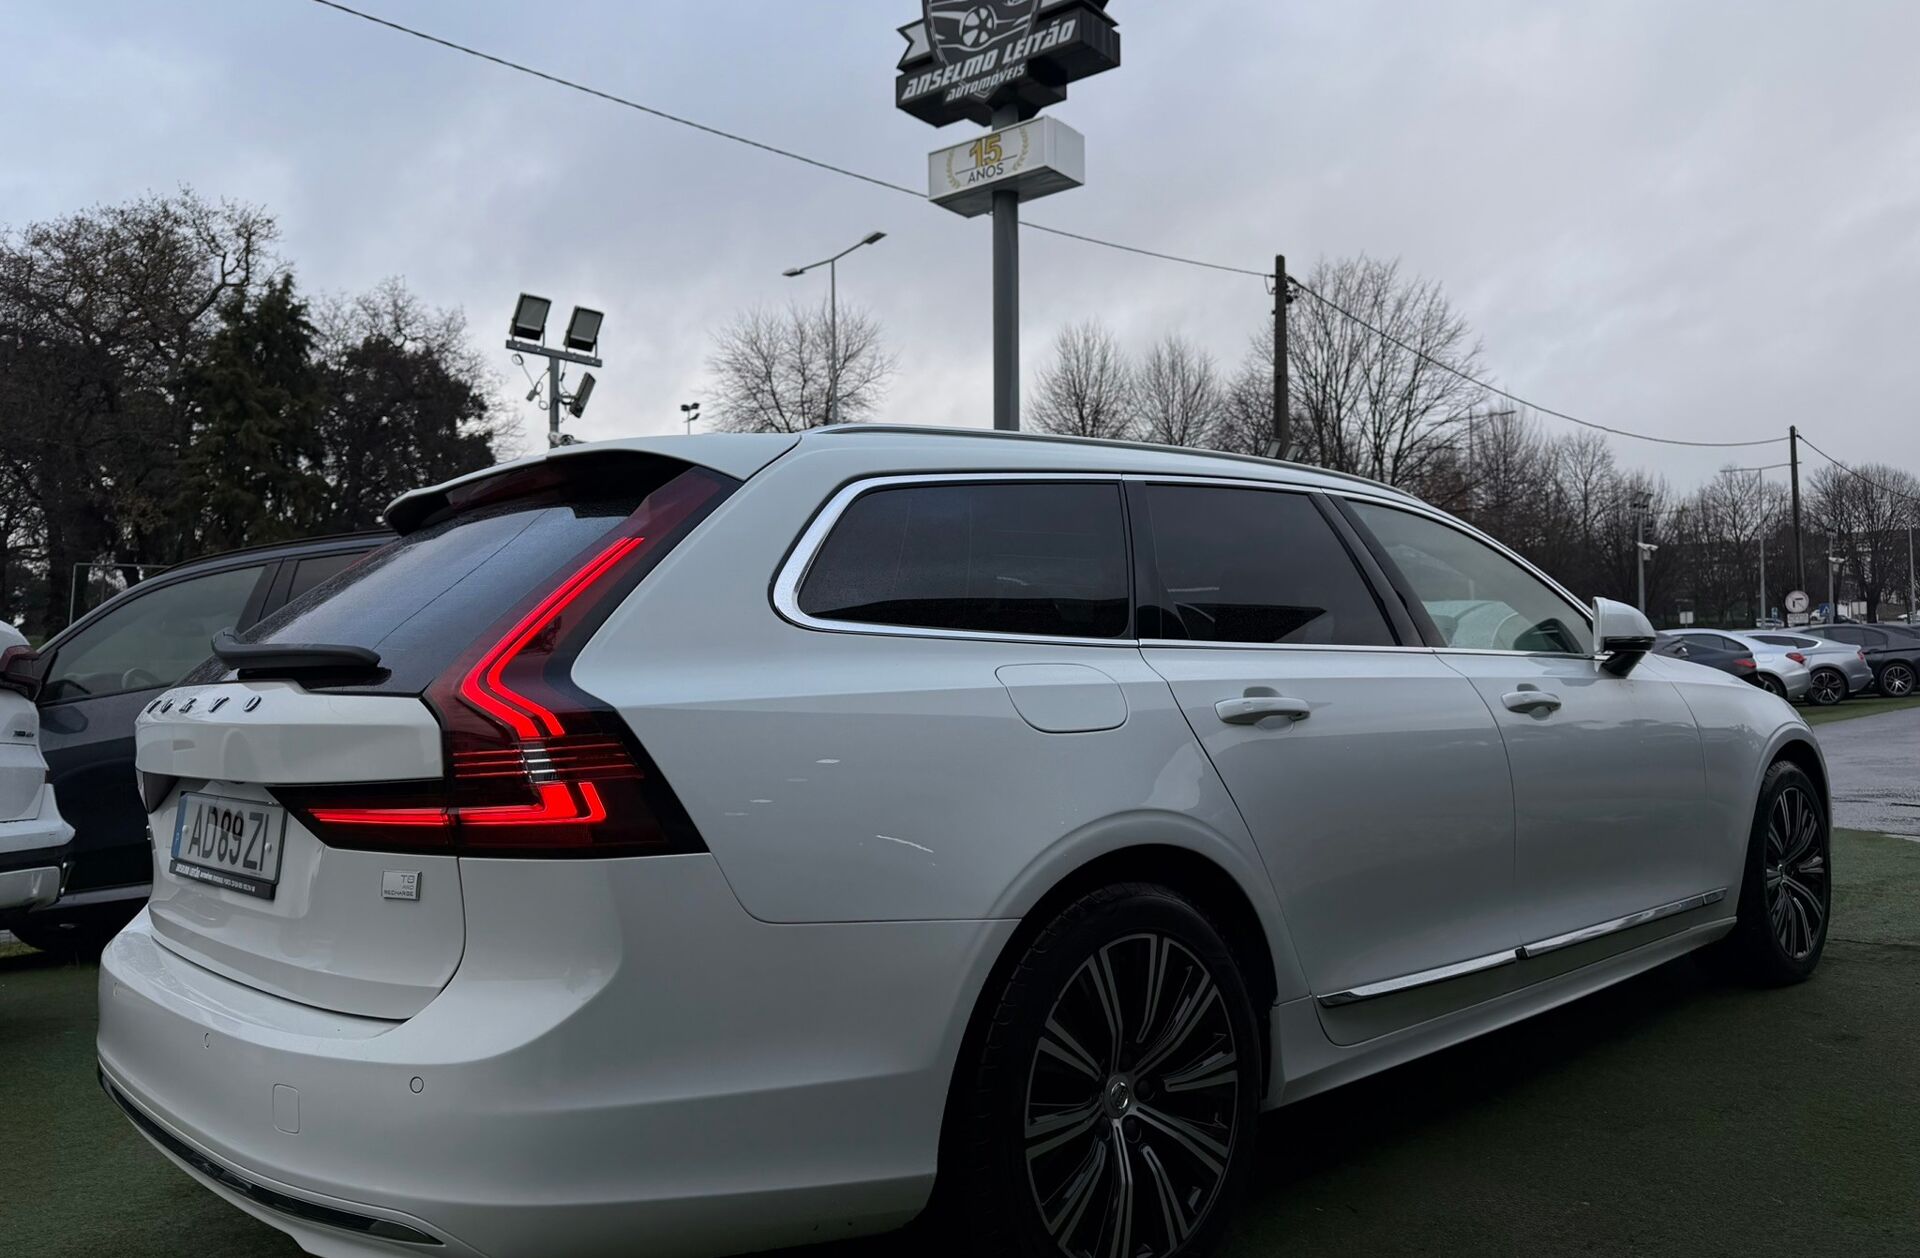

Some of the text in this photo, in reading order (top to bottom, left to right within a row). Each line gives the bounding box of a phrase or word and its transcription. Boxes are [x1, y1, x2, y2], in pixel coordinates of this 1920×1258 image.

[901, 19, 1076, 101] ANSELMO LEITÃO
[945, 63, 1026, 101] AUTOMÓVEIS
[969, 134, 1003, 169] 15
[967, 163, 1004, 185] ANOS
